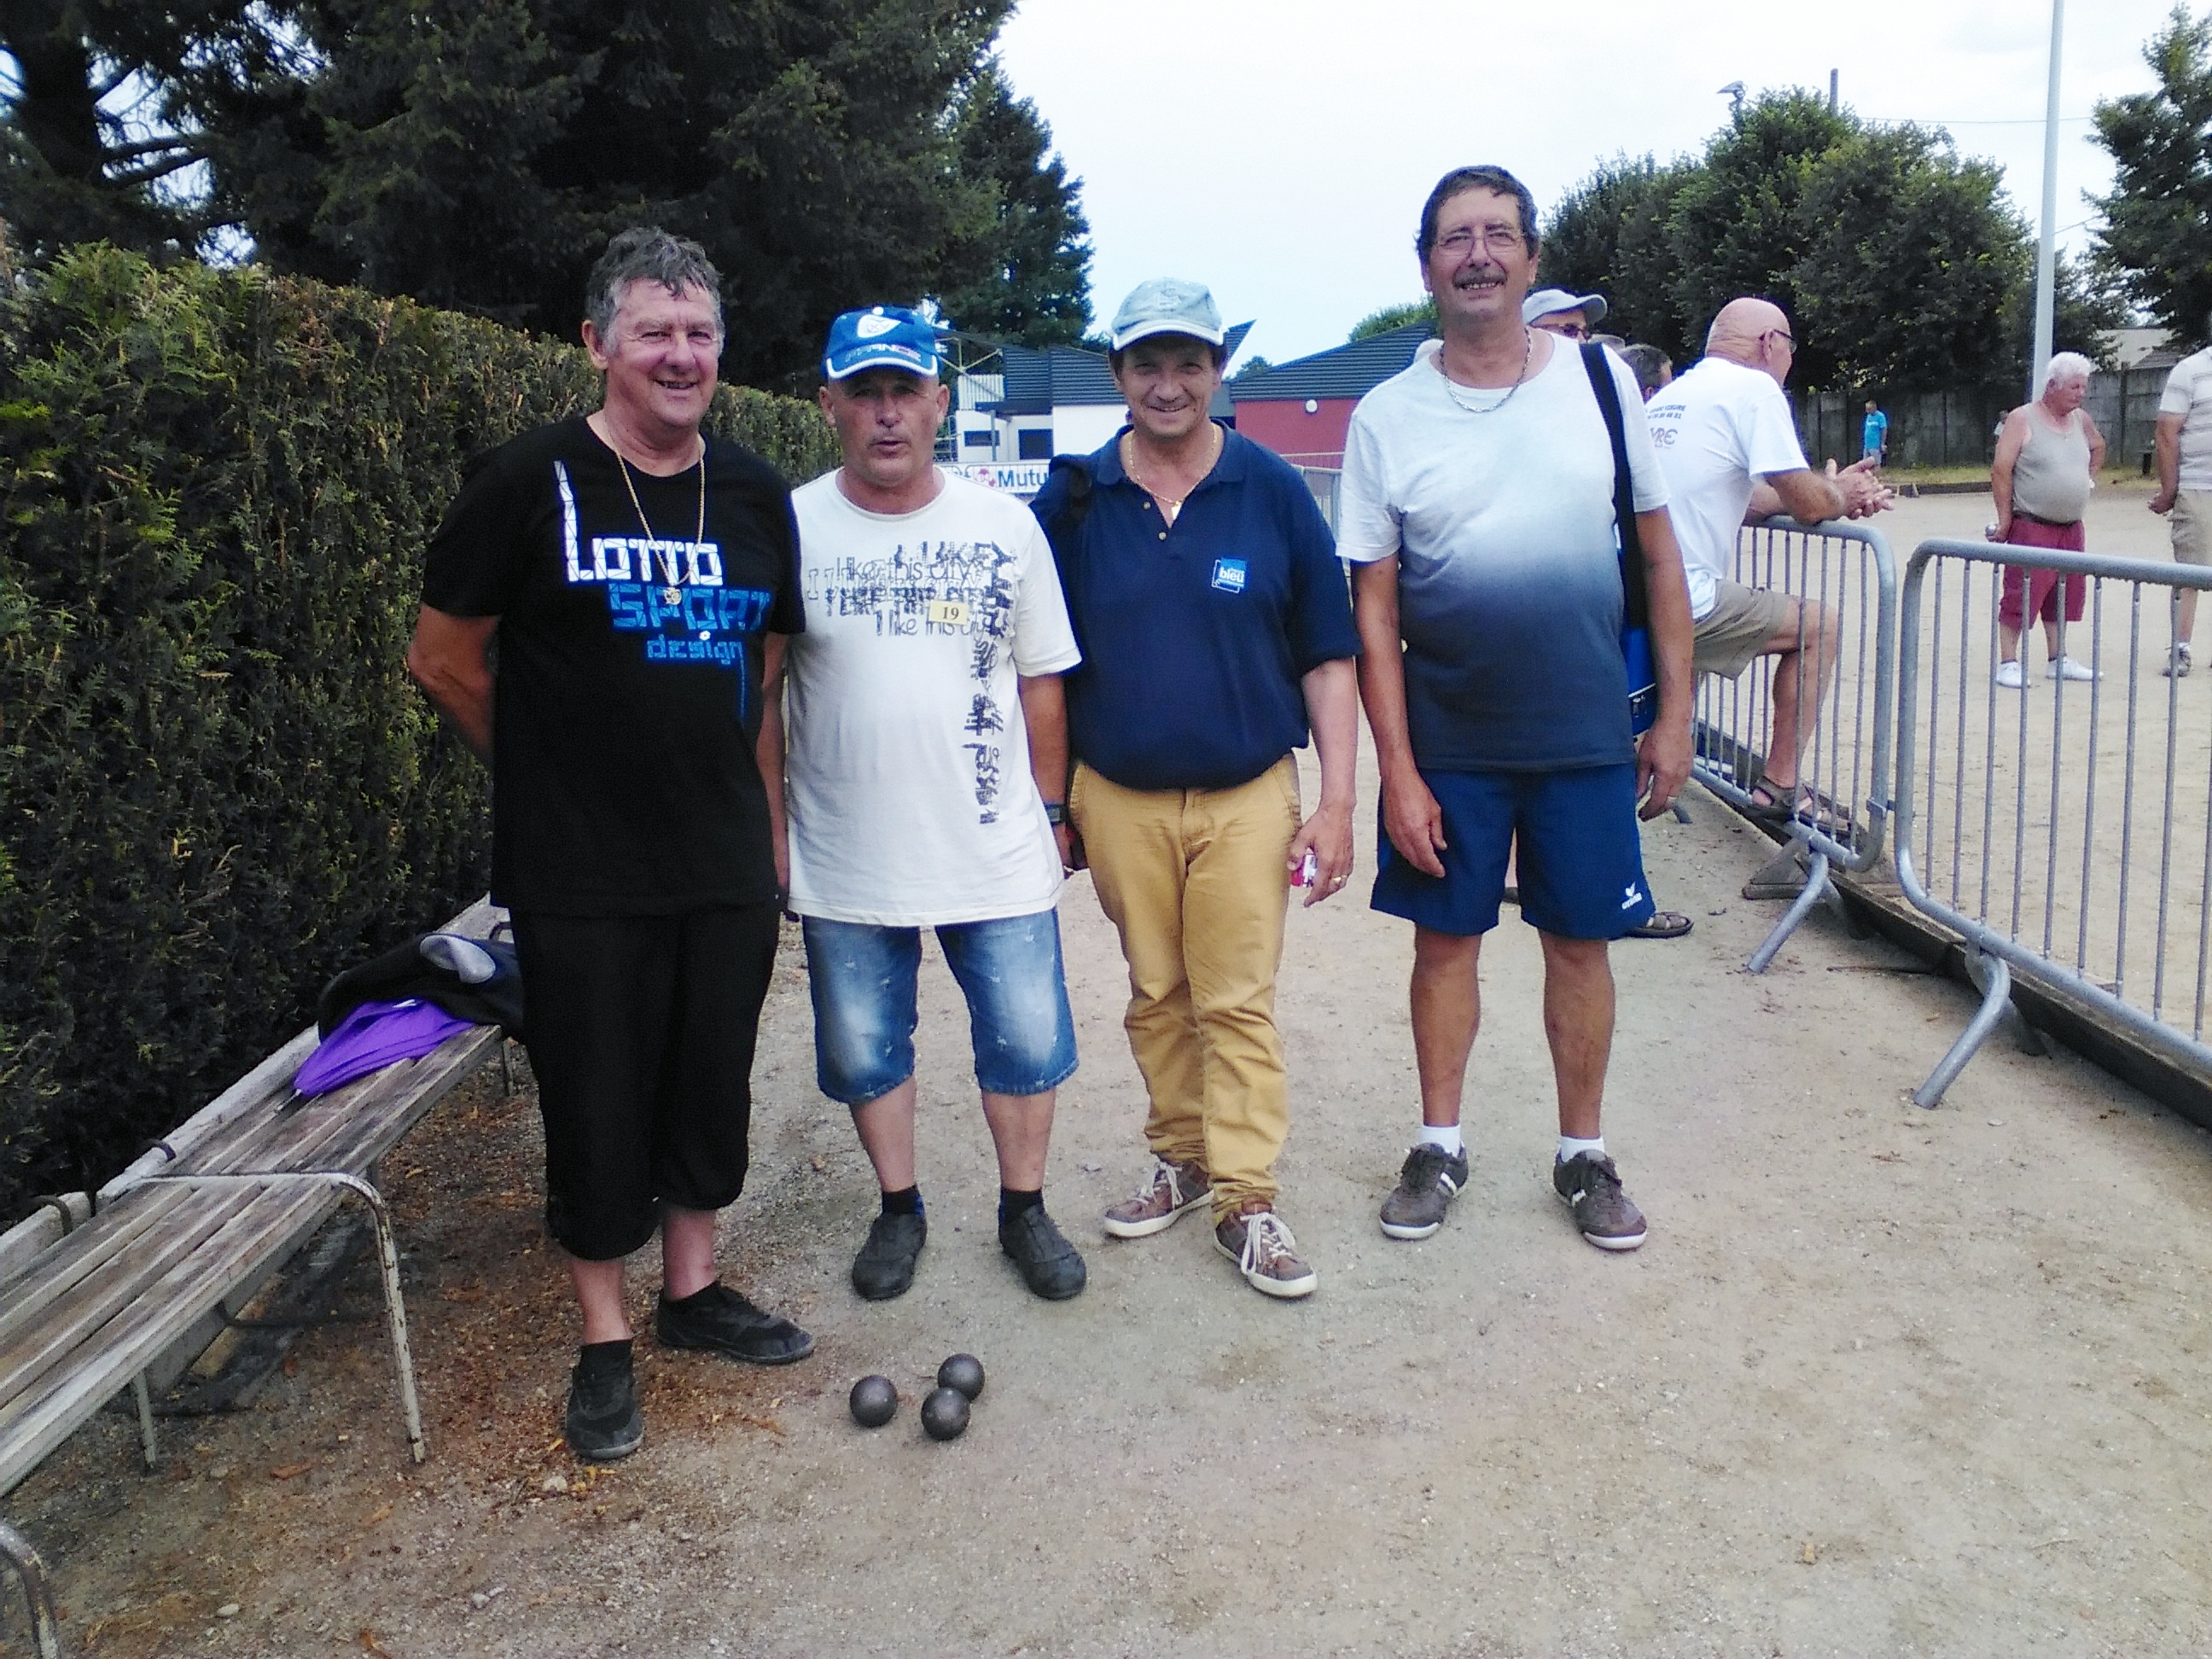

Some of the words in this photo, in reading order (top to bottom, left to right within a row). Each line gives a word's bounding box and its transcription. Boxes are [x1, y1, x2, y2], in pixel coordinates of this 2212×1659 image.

[1219, 566, 1246, 584] bleu
[942, 605, 960, 621] 19
[646, 634, 747, 666] design
